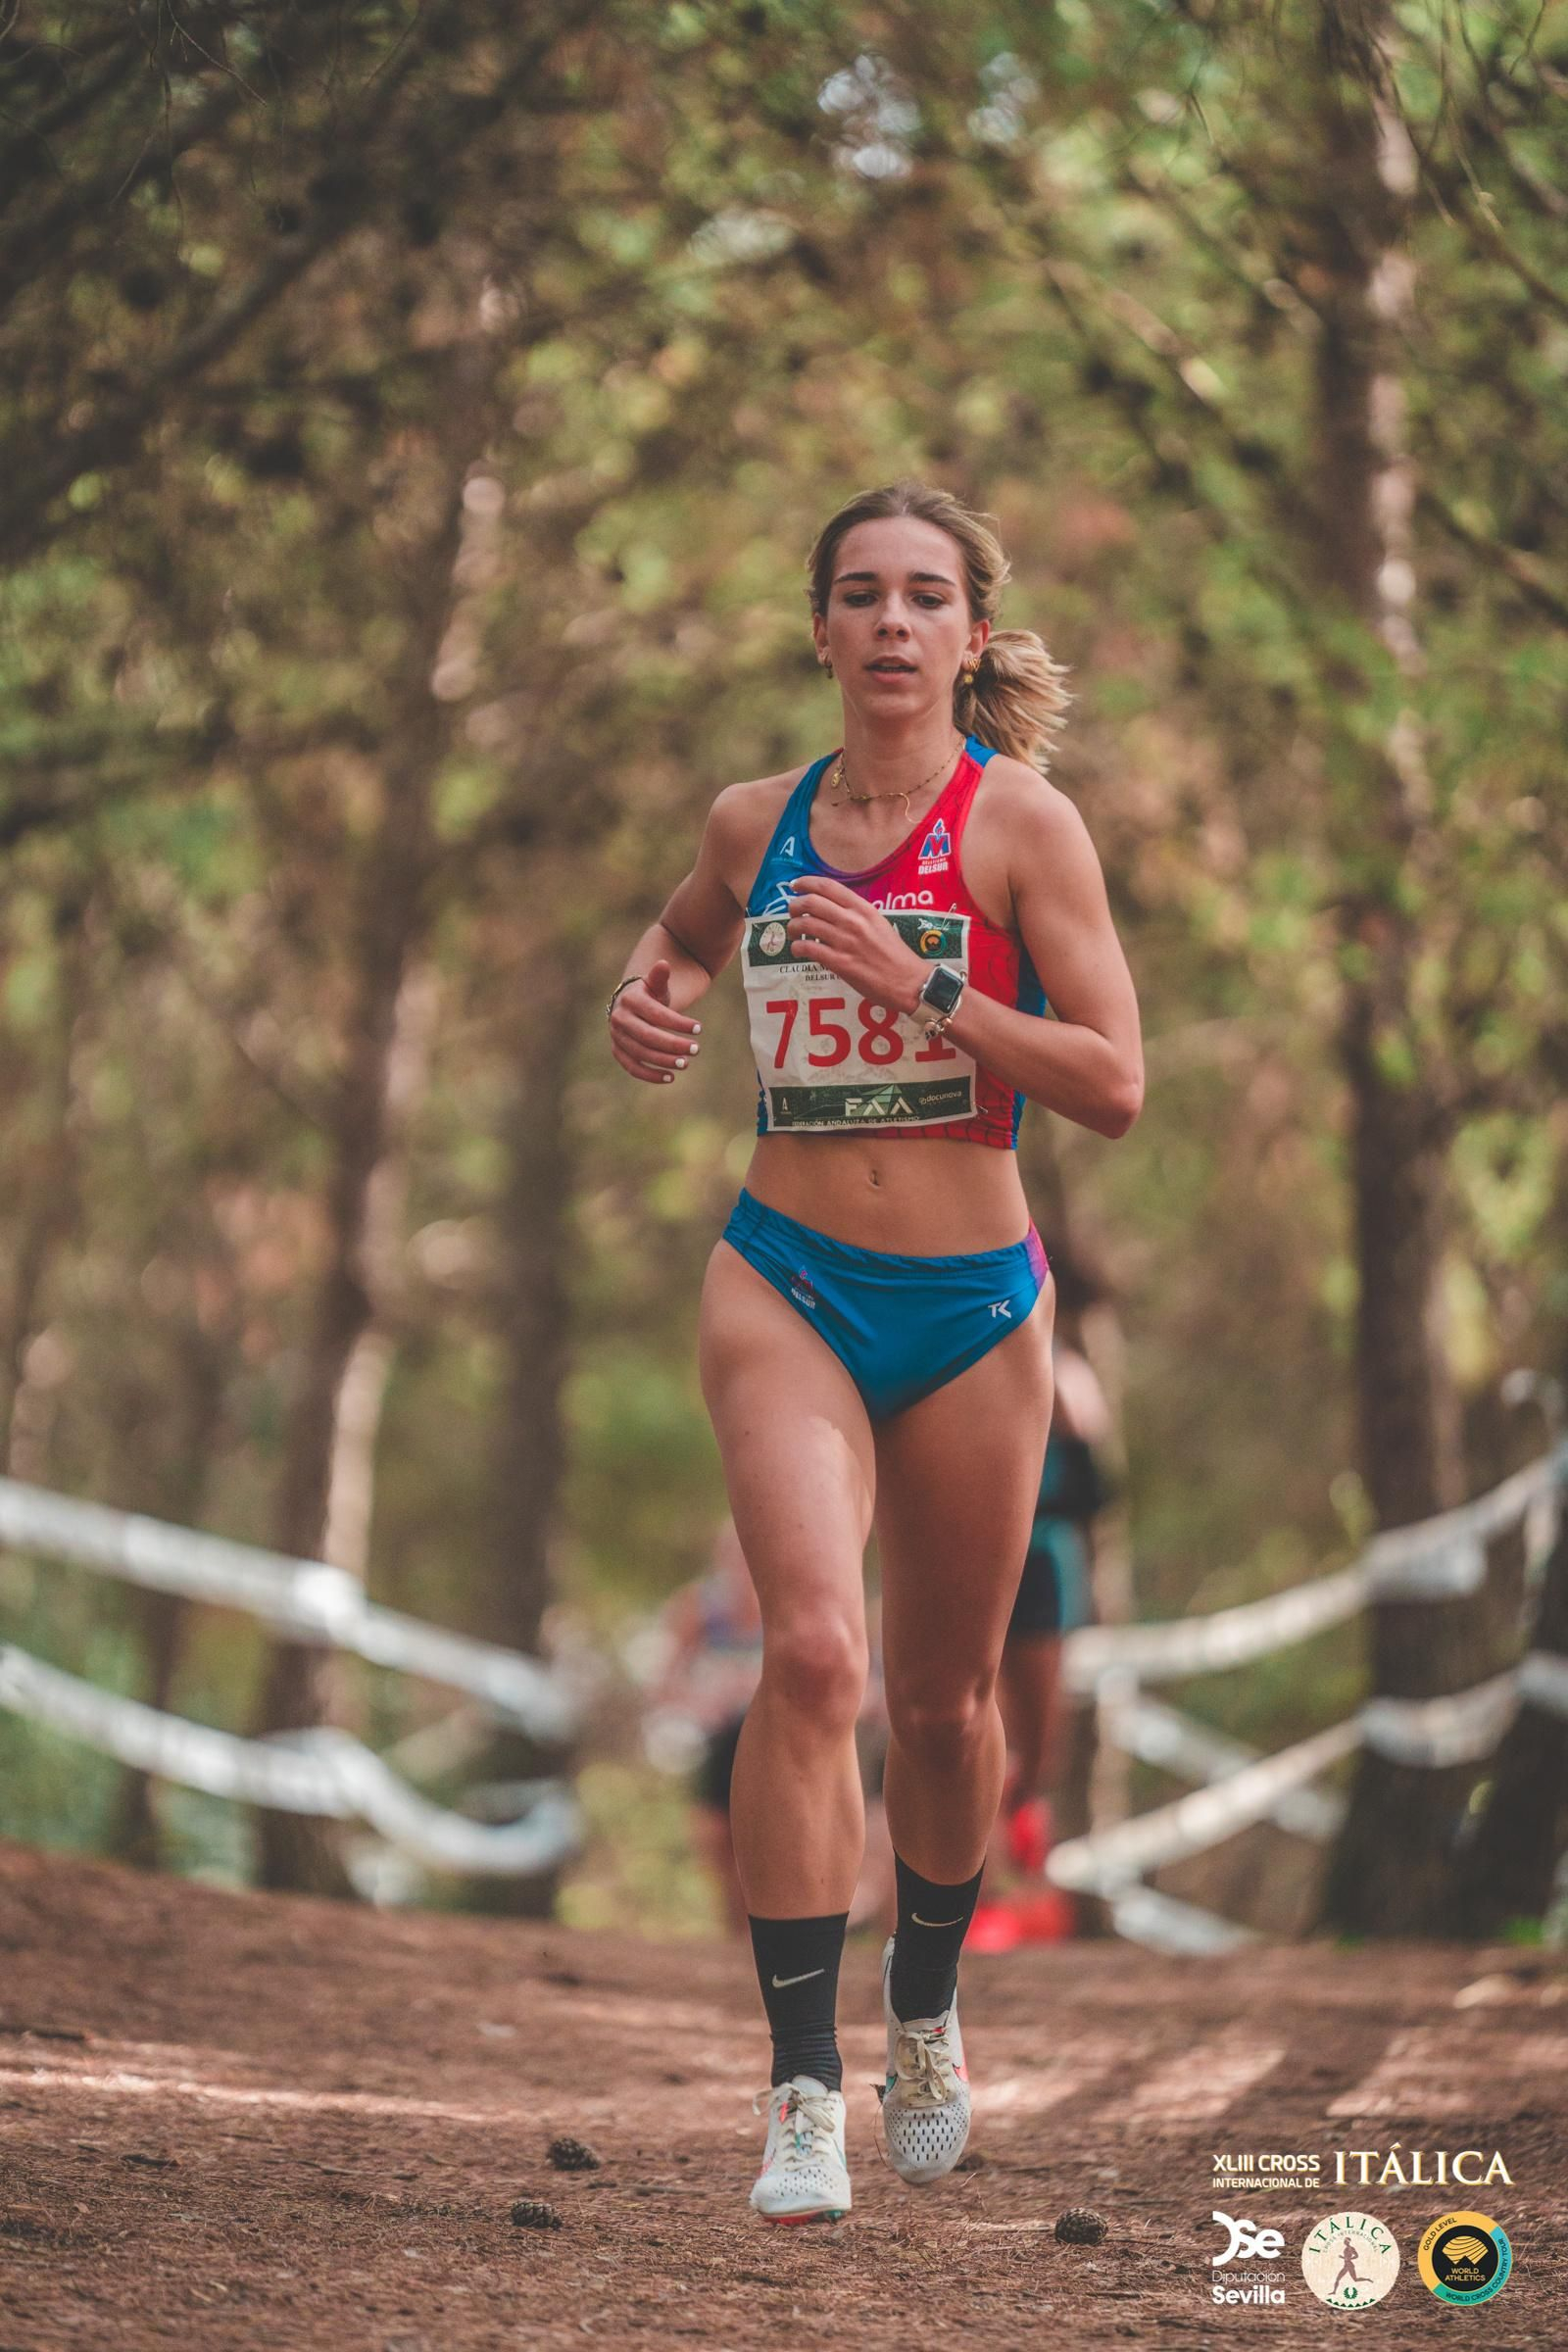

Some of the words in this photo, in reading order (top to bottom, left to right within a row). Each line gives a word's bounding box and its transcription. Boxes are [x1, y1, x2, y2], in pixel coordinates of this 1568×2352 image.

[918, 861, 949, 875] DELSUR
[779, 963, 818, 974] CLAUDIA
[805, 973, 836, 982] DELSUR
